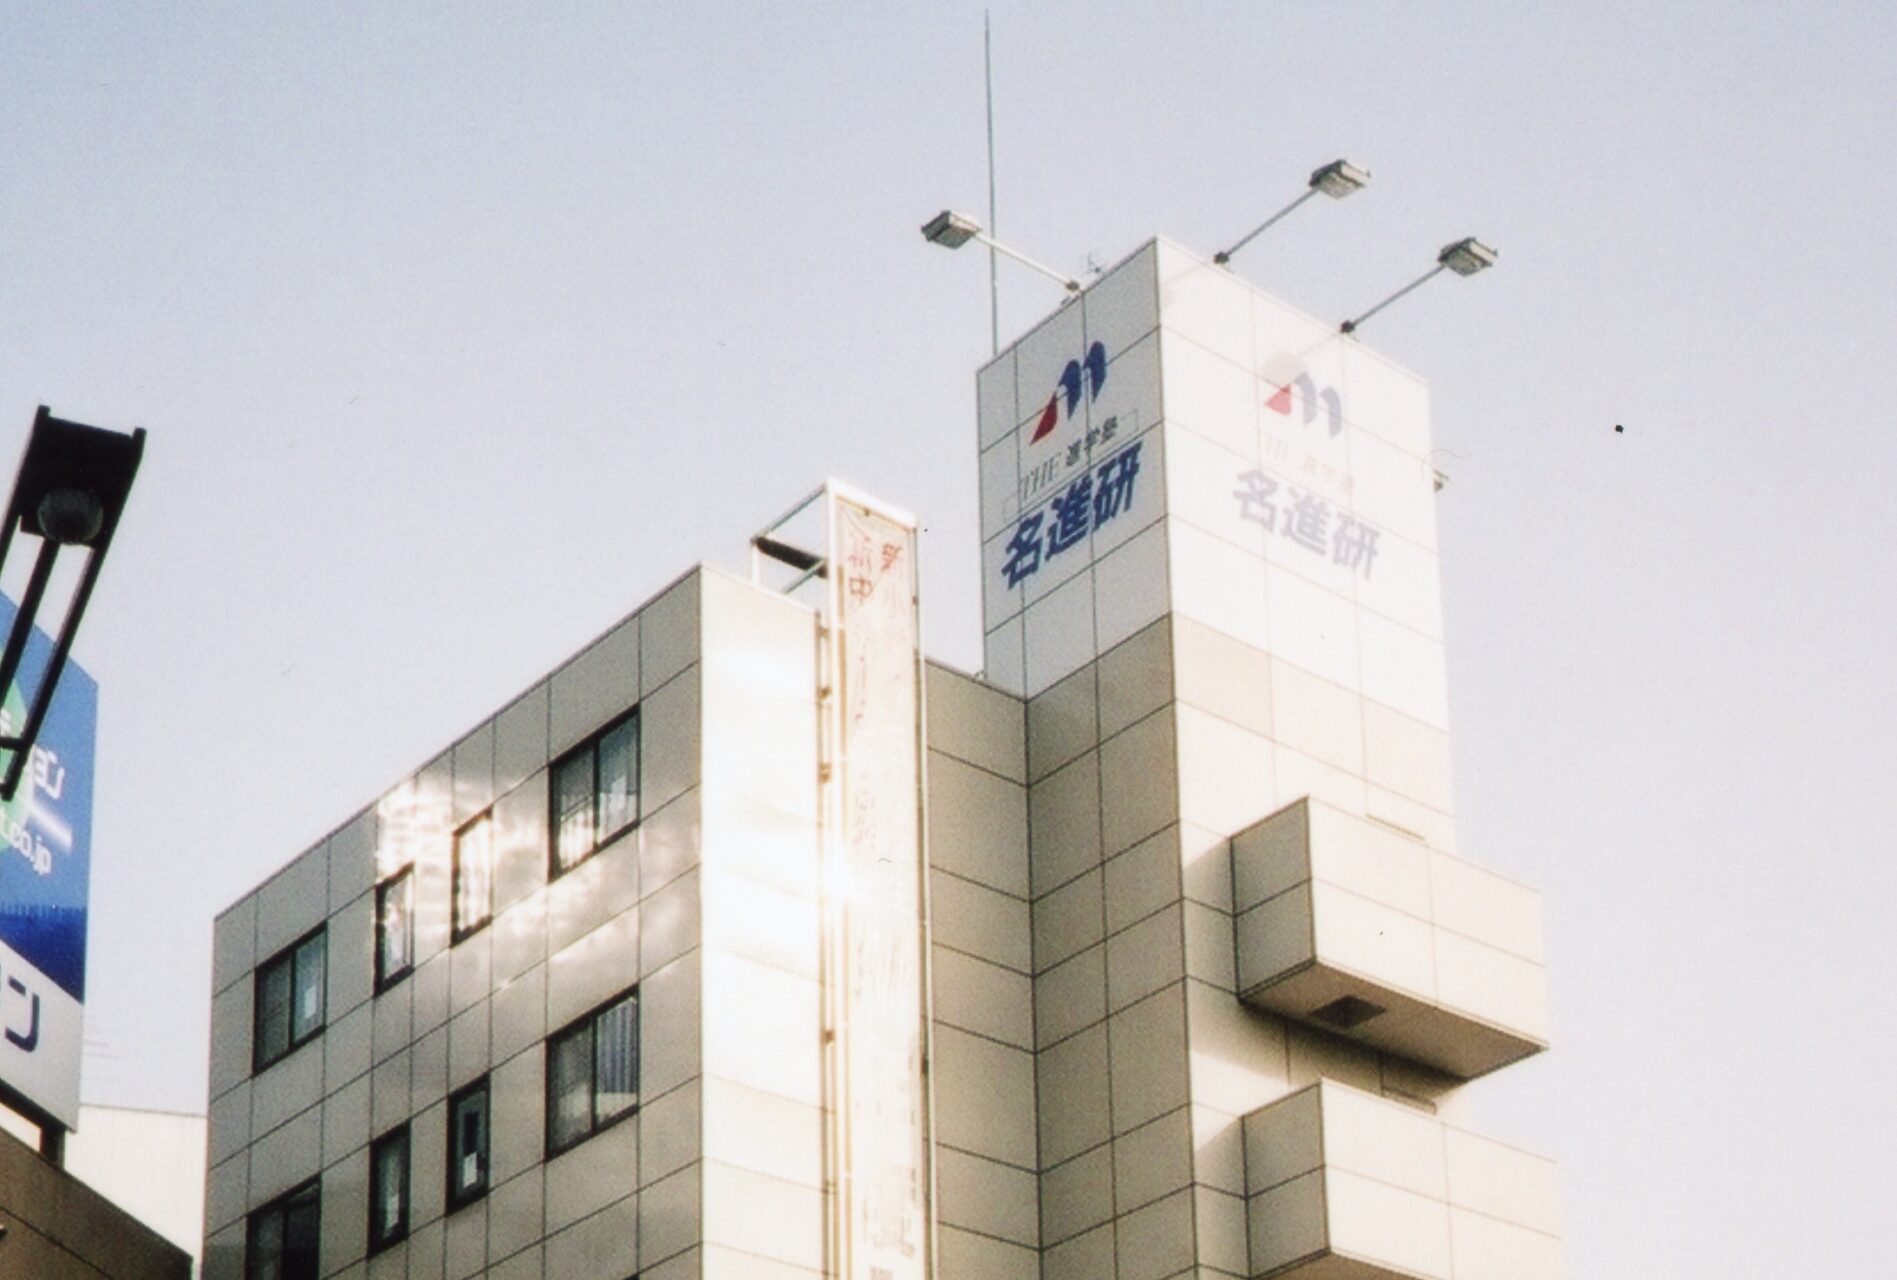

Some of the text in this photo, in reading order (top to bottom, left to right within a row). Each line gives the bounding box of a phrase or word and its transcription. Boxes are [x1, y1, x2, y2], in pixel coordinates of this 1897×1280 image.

[1001, 440, 1143, 591] 名進研
[1233, 468, 1381, 581] 名進研
